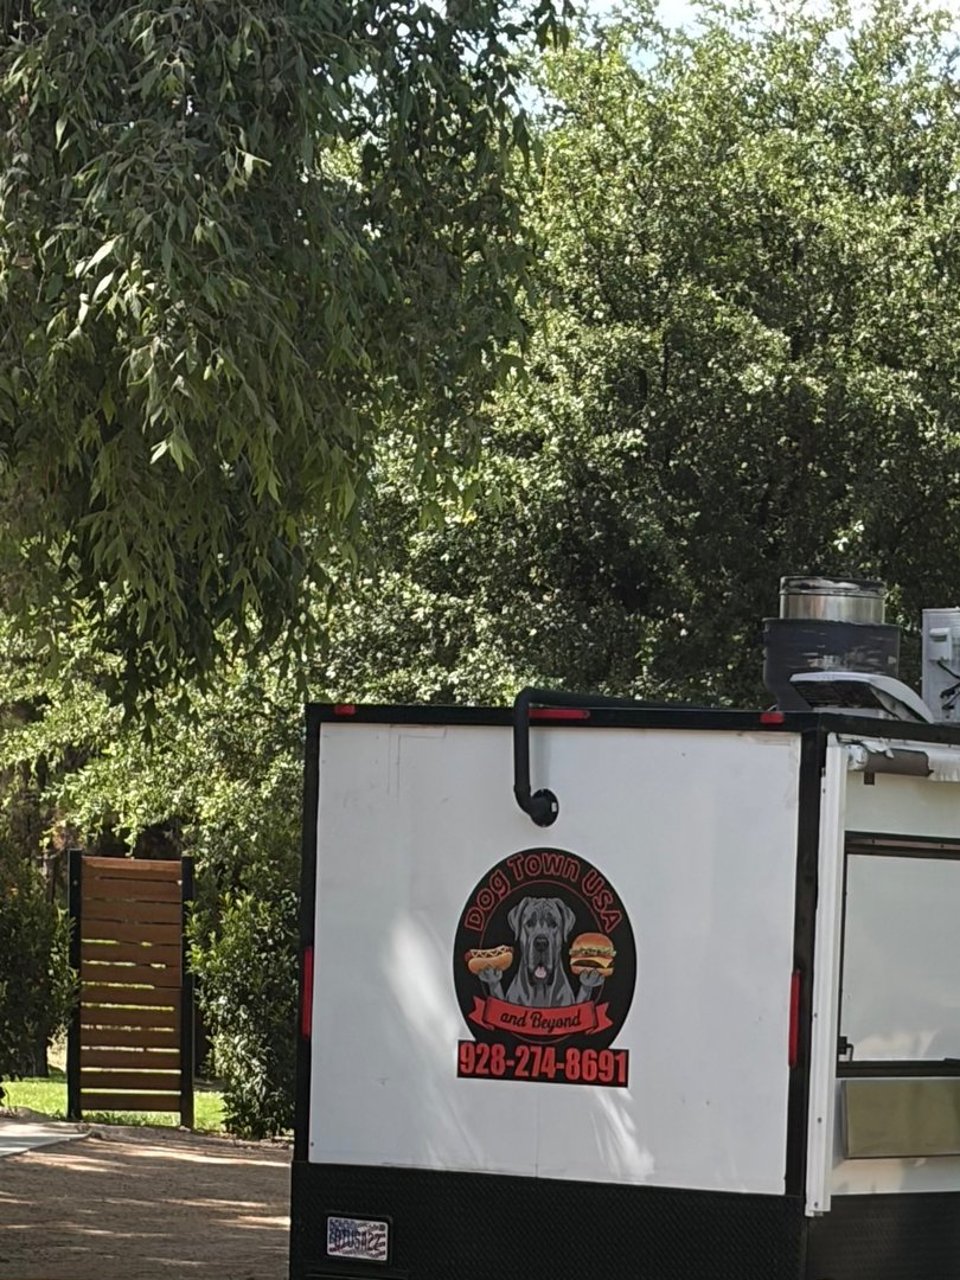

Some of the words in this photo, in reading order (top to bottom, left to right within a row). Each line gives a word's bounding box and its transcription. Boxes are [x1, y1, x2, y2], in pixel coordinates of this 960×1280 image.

[581, 869, 623, 933] USA
[500, 1010, 527, 1028] and
[530, 1011, 582, 1033] Beyond
[459, 1042, 627, 1083] 928-274-8691
